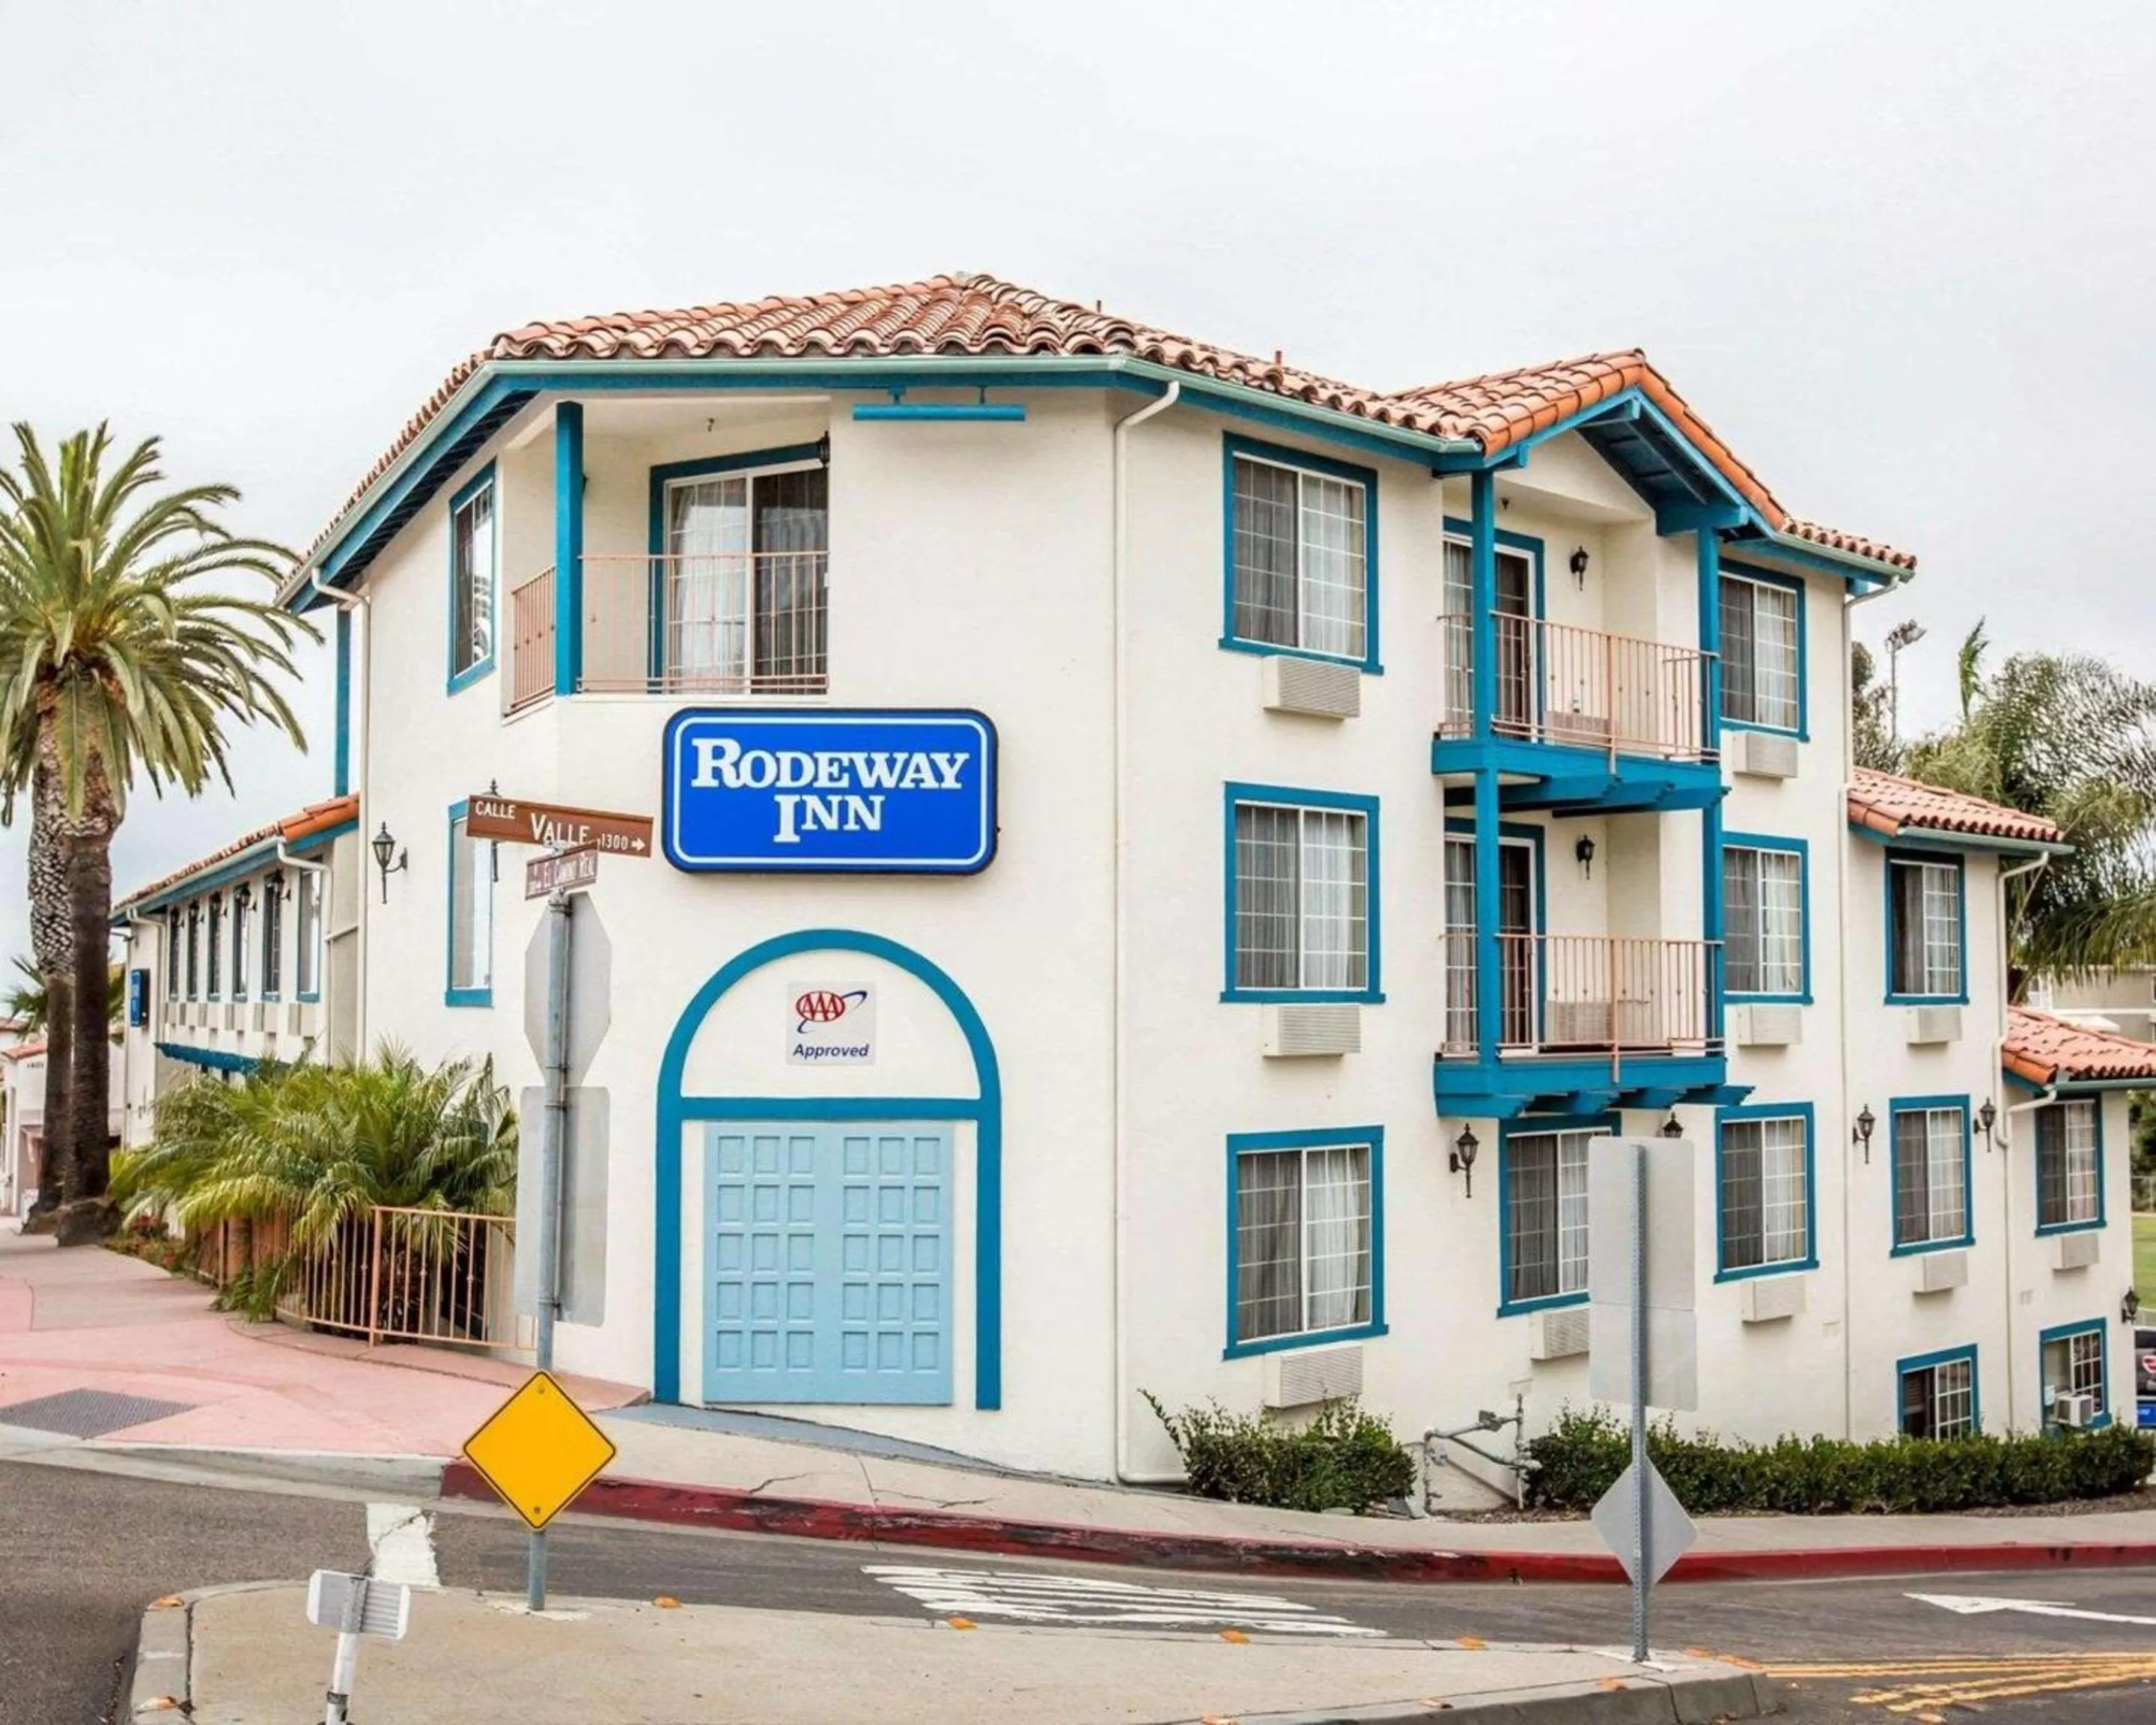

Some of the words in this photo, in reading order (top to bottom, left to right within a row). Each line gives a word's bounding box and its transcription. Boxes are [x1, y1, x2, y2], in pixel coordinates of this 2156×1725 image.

[691, 737, 969, 789] RODEWAY
[474, 800, 517, 819] CALLE
[531, 813, 590, 845] VALLE
[601, 833, 628, 851] 1300
[773, 794, 885, 843] INN
[798, 991, 843, 1021] AAA
[793, 1043, 869, 1059] Approved
